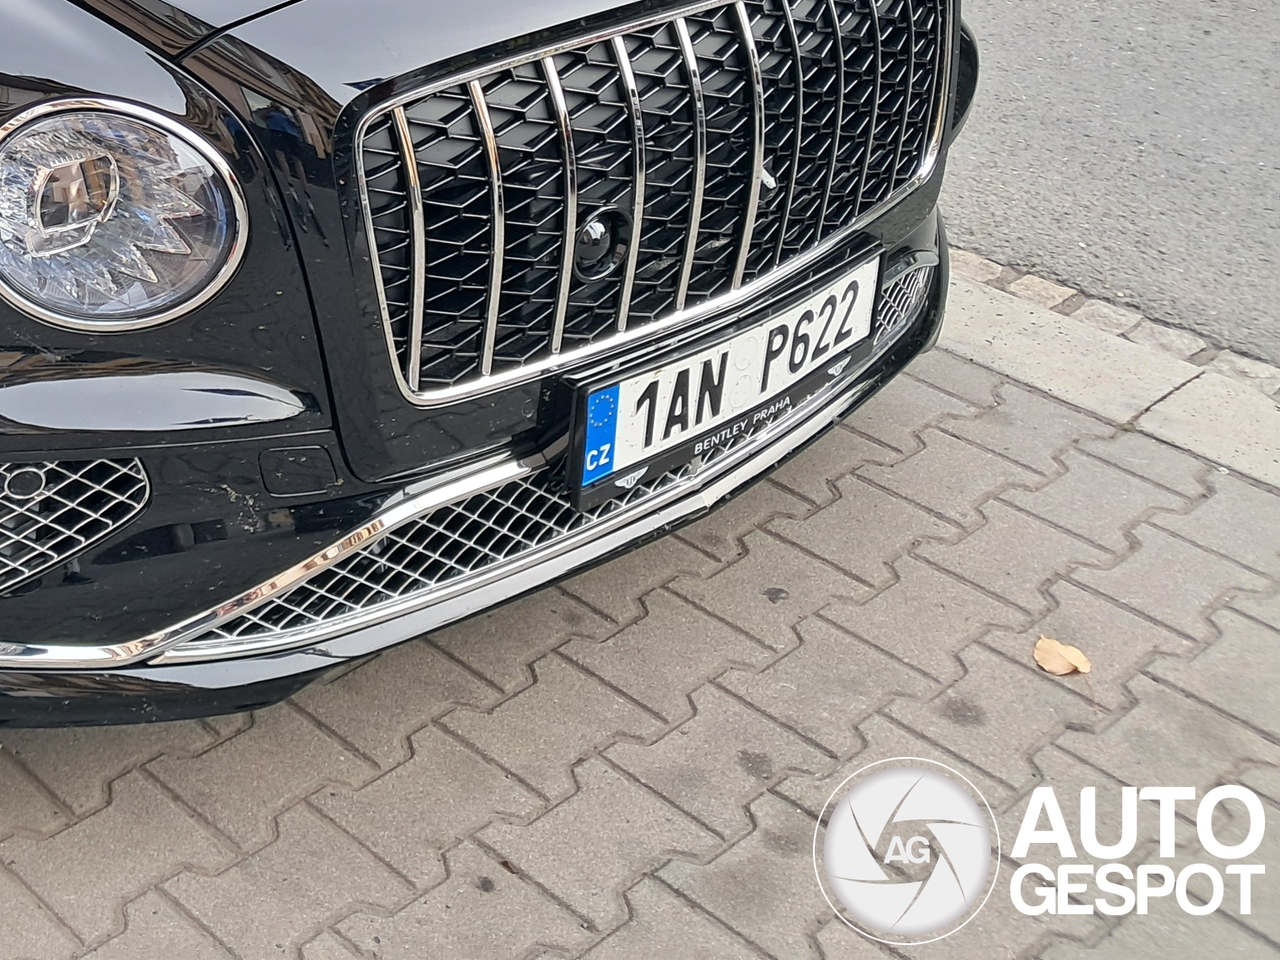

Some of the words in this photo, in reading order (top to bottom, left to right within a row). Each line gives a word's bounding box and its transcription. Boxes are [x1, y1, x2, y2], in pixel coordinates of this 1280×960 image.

[635, 350, 729, 450] 1AN
[760, 279, 860, 394] P622
[693, 418, 749, 455] BENTLEY
[752, 395, 791, 425] PRAHA
[586, 442, 612, 471] CZ
